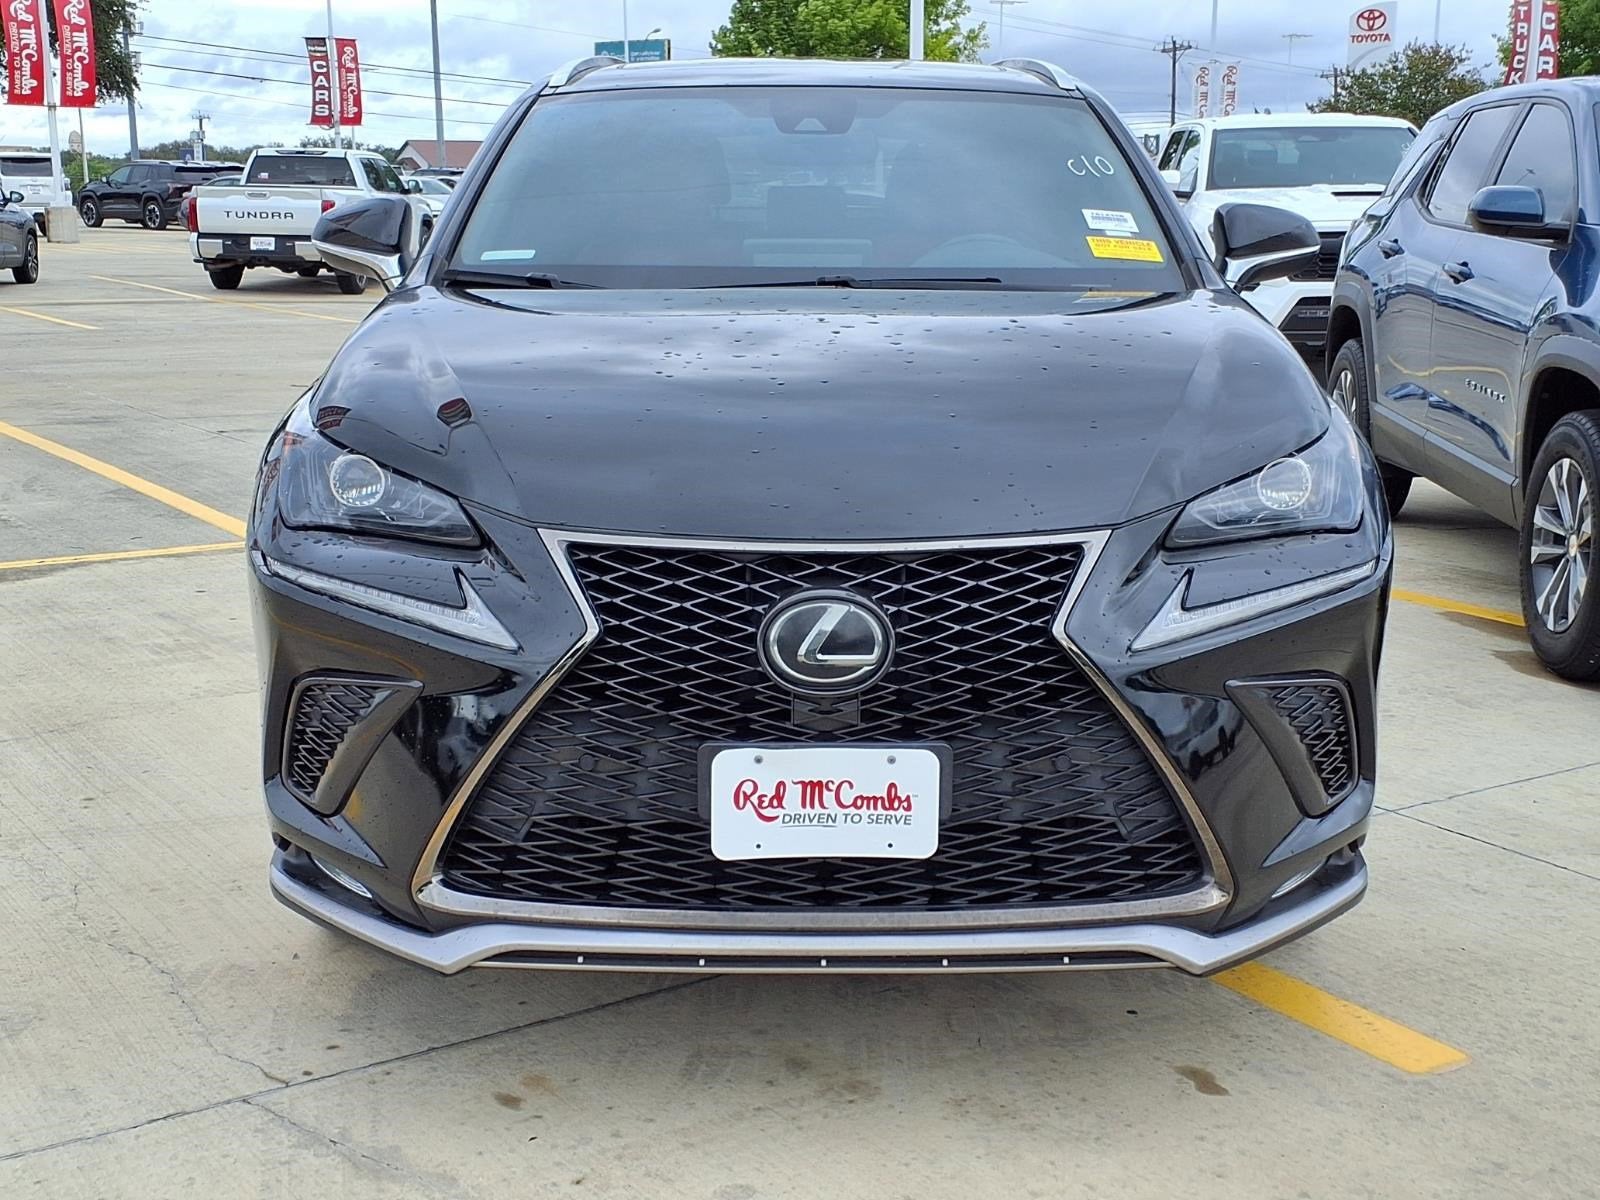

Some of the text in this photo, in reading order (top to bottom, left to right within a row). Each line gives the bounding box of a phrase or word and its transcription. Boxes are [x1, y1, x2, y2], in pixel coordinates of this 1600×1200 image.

[9, 22, 20, 53] DRIVEN
[61, 25, 72, 55] DRIVEN
[1350, 33, 1391, 44] TOYOTA
[1537, 12, 1556, 80] CAR
[14, 56, 20, 68] TO
[19, 24, 38, 95] McCombs
[66, 58, 72, 70] TO
[72, 27, 90, 97] McCombs
[342, 46, 356, 69] Red
[1196, 66, 1209, 87] Red
[1222, 65, 1238, 86] Red
[312, 61, 329, 116] CARS
[224, 210, 294, 219] TUNDRA
[733, 778, 912, 823] Red McCombs
[781, 813, 913, 828] DRIVEN TO SERVE
